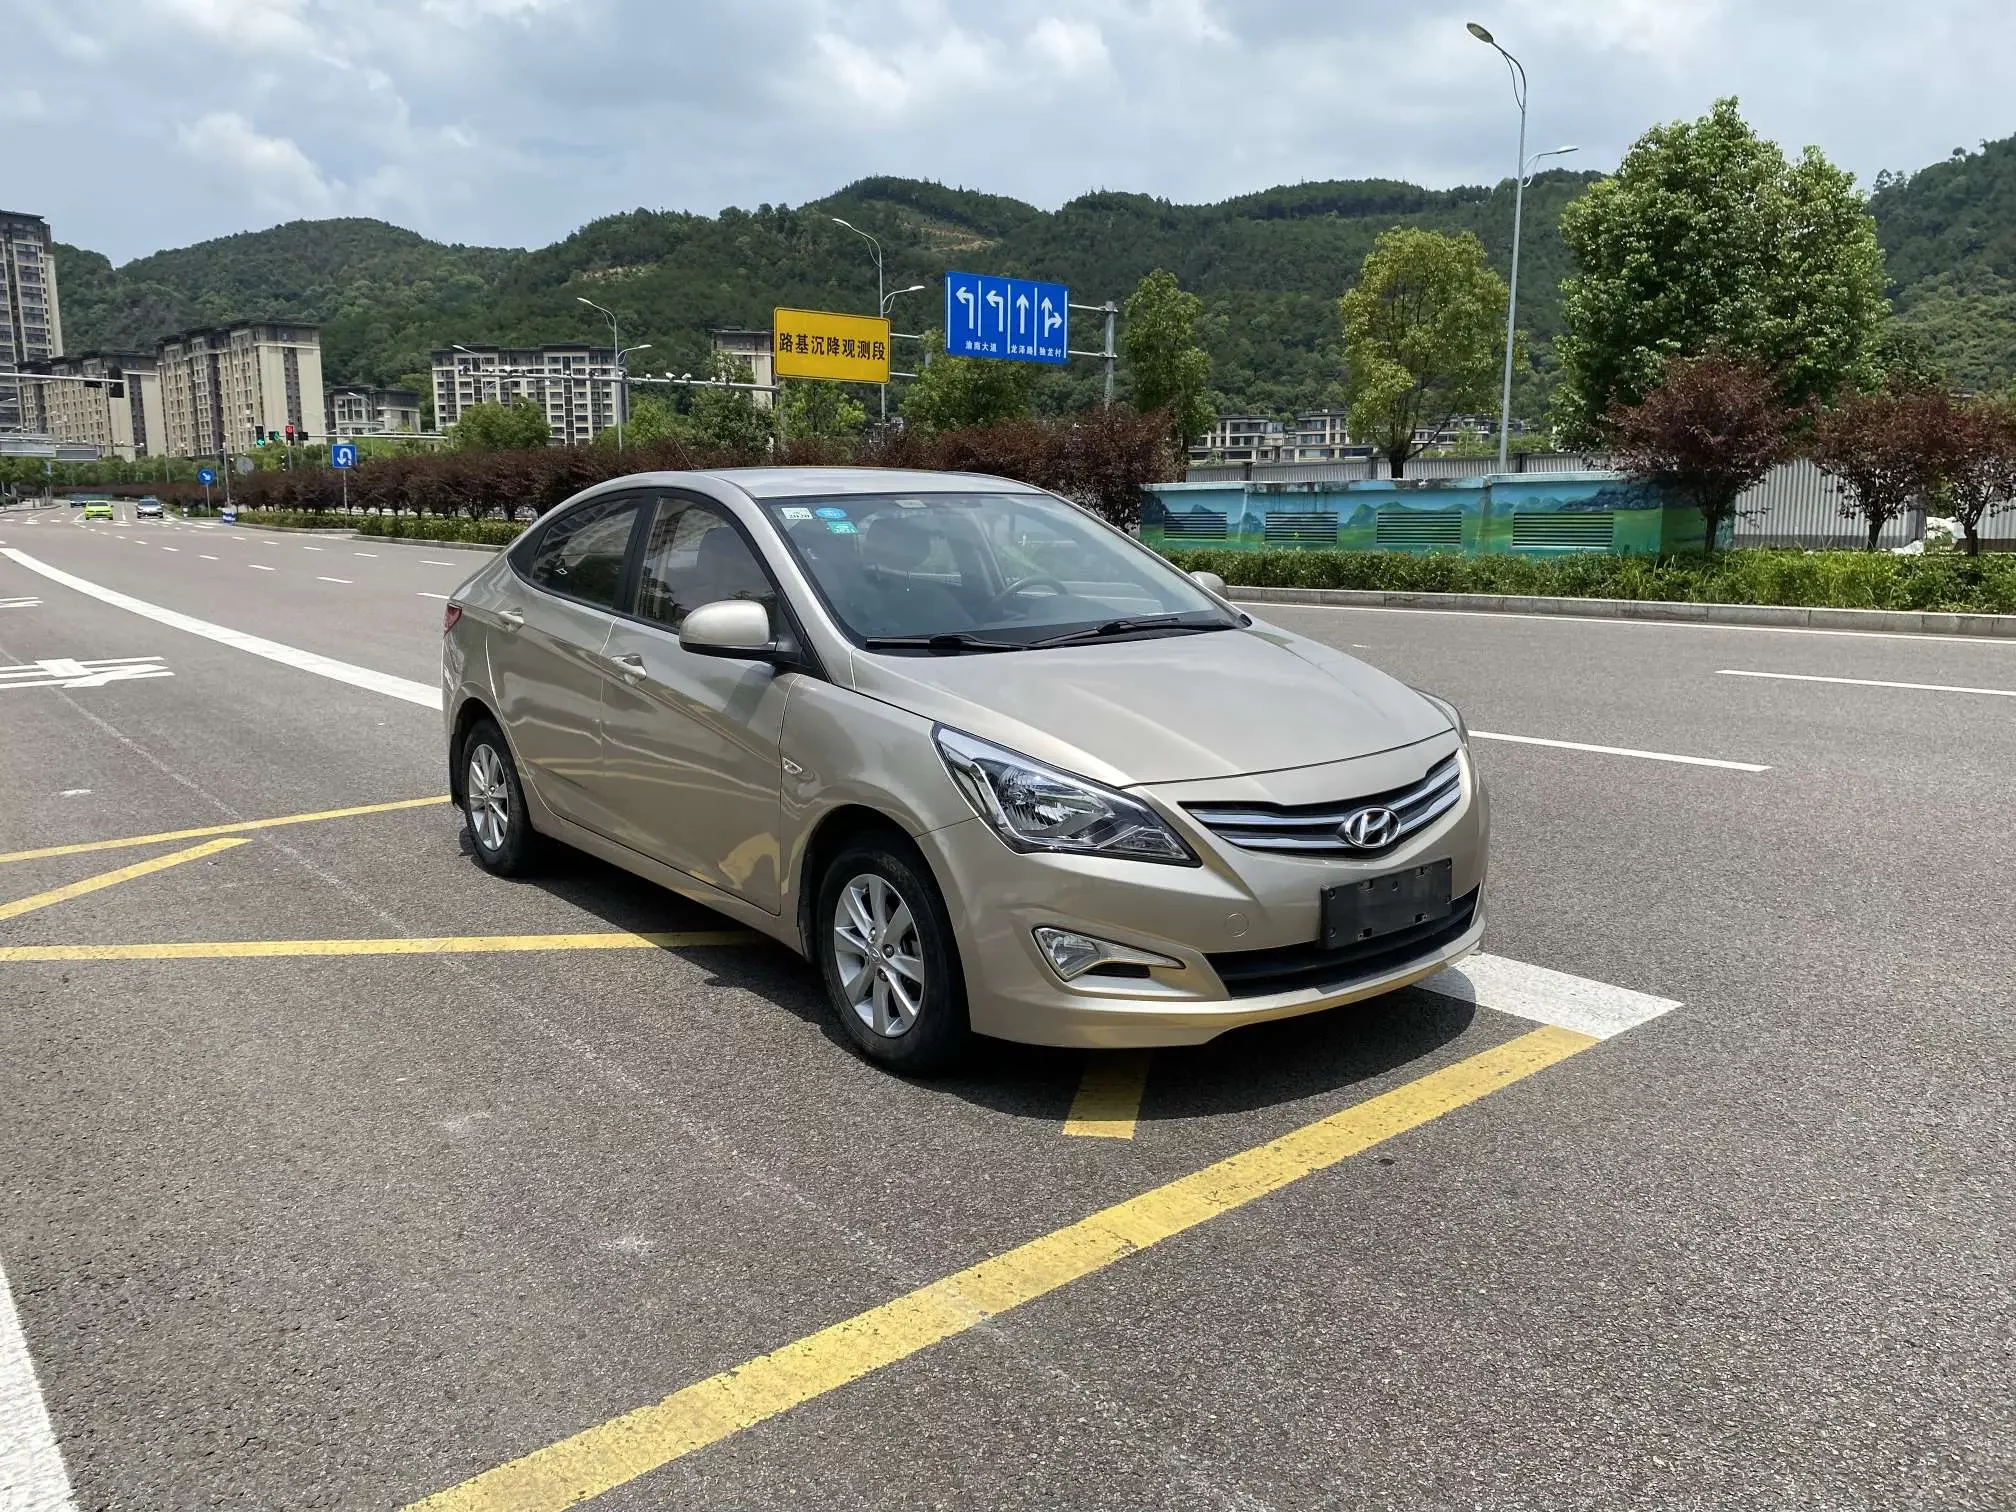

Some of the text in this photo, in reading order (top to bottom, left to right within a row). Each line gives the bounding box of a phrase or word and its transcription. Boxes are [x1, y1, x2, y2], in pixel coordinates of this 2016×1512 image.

[779, 332, 886, 361] 路基沉降观测段
[965, 340, 997, 353] 渝南大道
